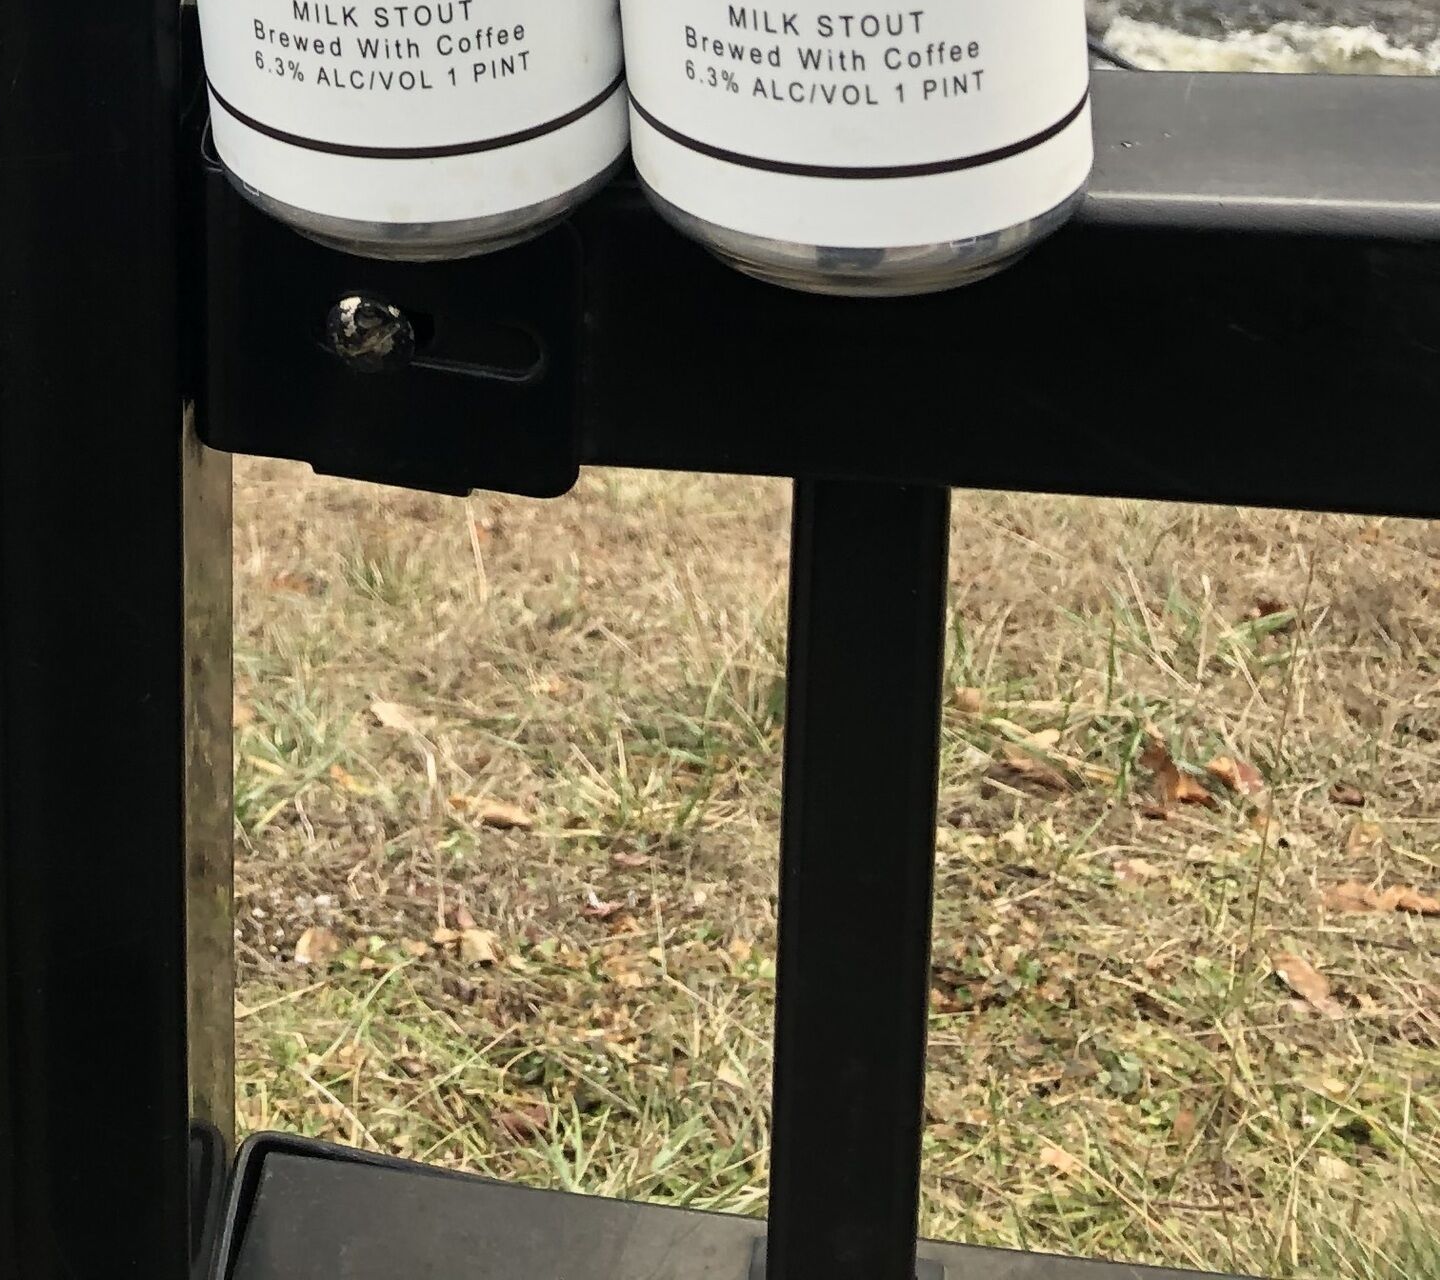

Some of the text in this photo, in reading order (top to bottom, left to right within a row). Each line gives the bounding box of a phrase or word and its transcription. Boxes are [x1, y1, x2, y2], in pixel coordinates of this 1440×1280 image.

[292, 0, 474, 30] MILK STOUT
[728, 5, 925, 39] MILK STOUT
[253, 19, 526, 59] Brewed With Coffee
[685, 25, 980, 71] Brewed With Coffee
[255, 50, 531, 91] 6.3% ALC/VOL 1 PINT
[685, 59, 986, 106] 6.3% ALC/VOL 1 PINT
